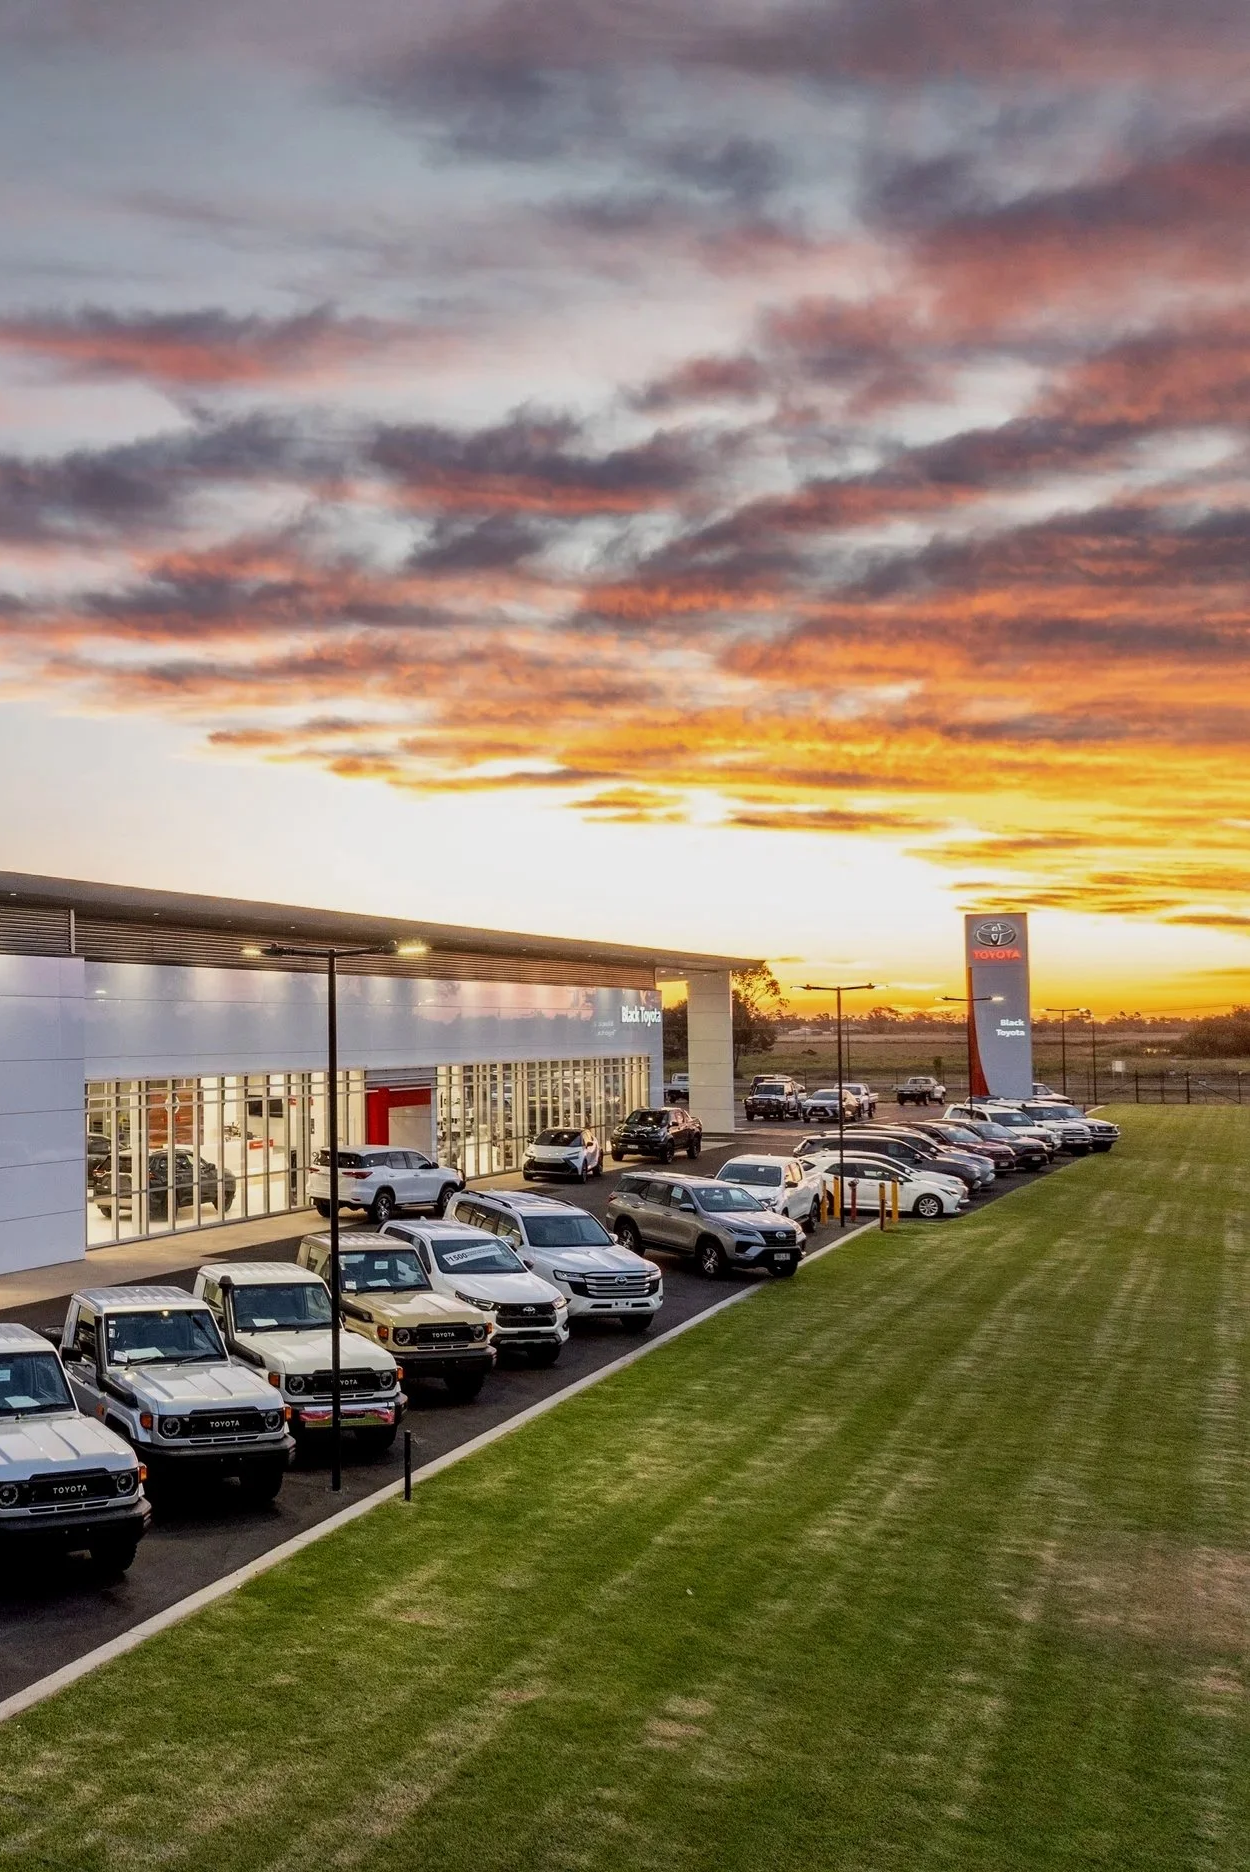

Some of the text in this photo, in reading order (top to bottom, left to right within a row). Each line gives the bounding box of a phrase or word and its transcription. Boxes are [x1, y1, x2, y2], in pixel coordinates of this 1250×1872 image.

[973, 949, 1022, 960] TOYOTA
[621, 1005, 661, 1027] Black Toyota
[996, 1029, 1025, 1037] Toyota
[210, 1420, 240, 1428] TOYOTA
[53, 1484, 87, 1494] TOYOTA
